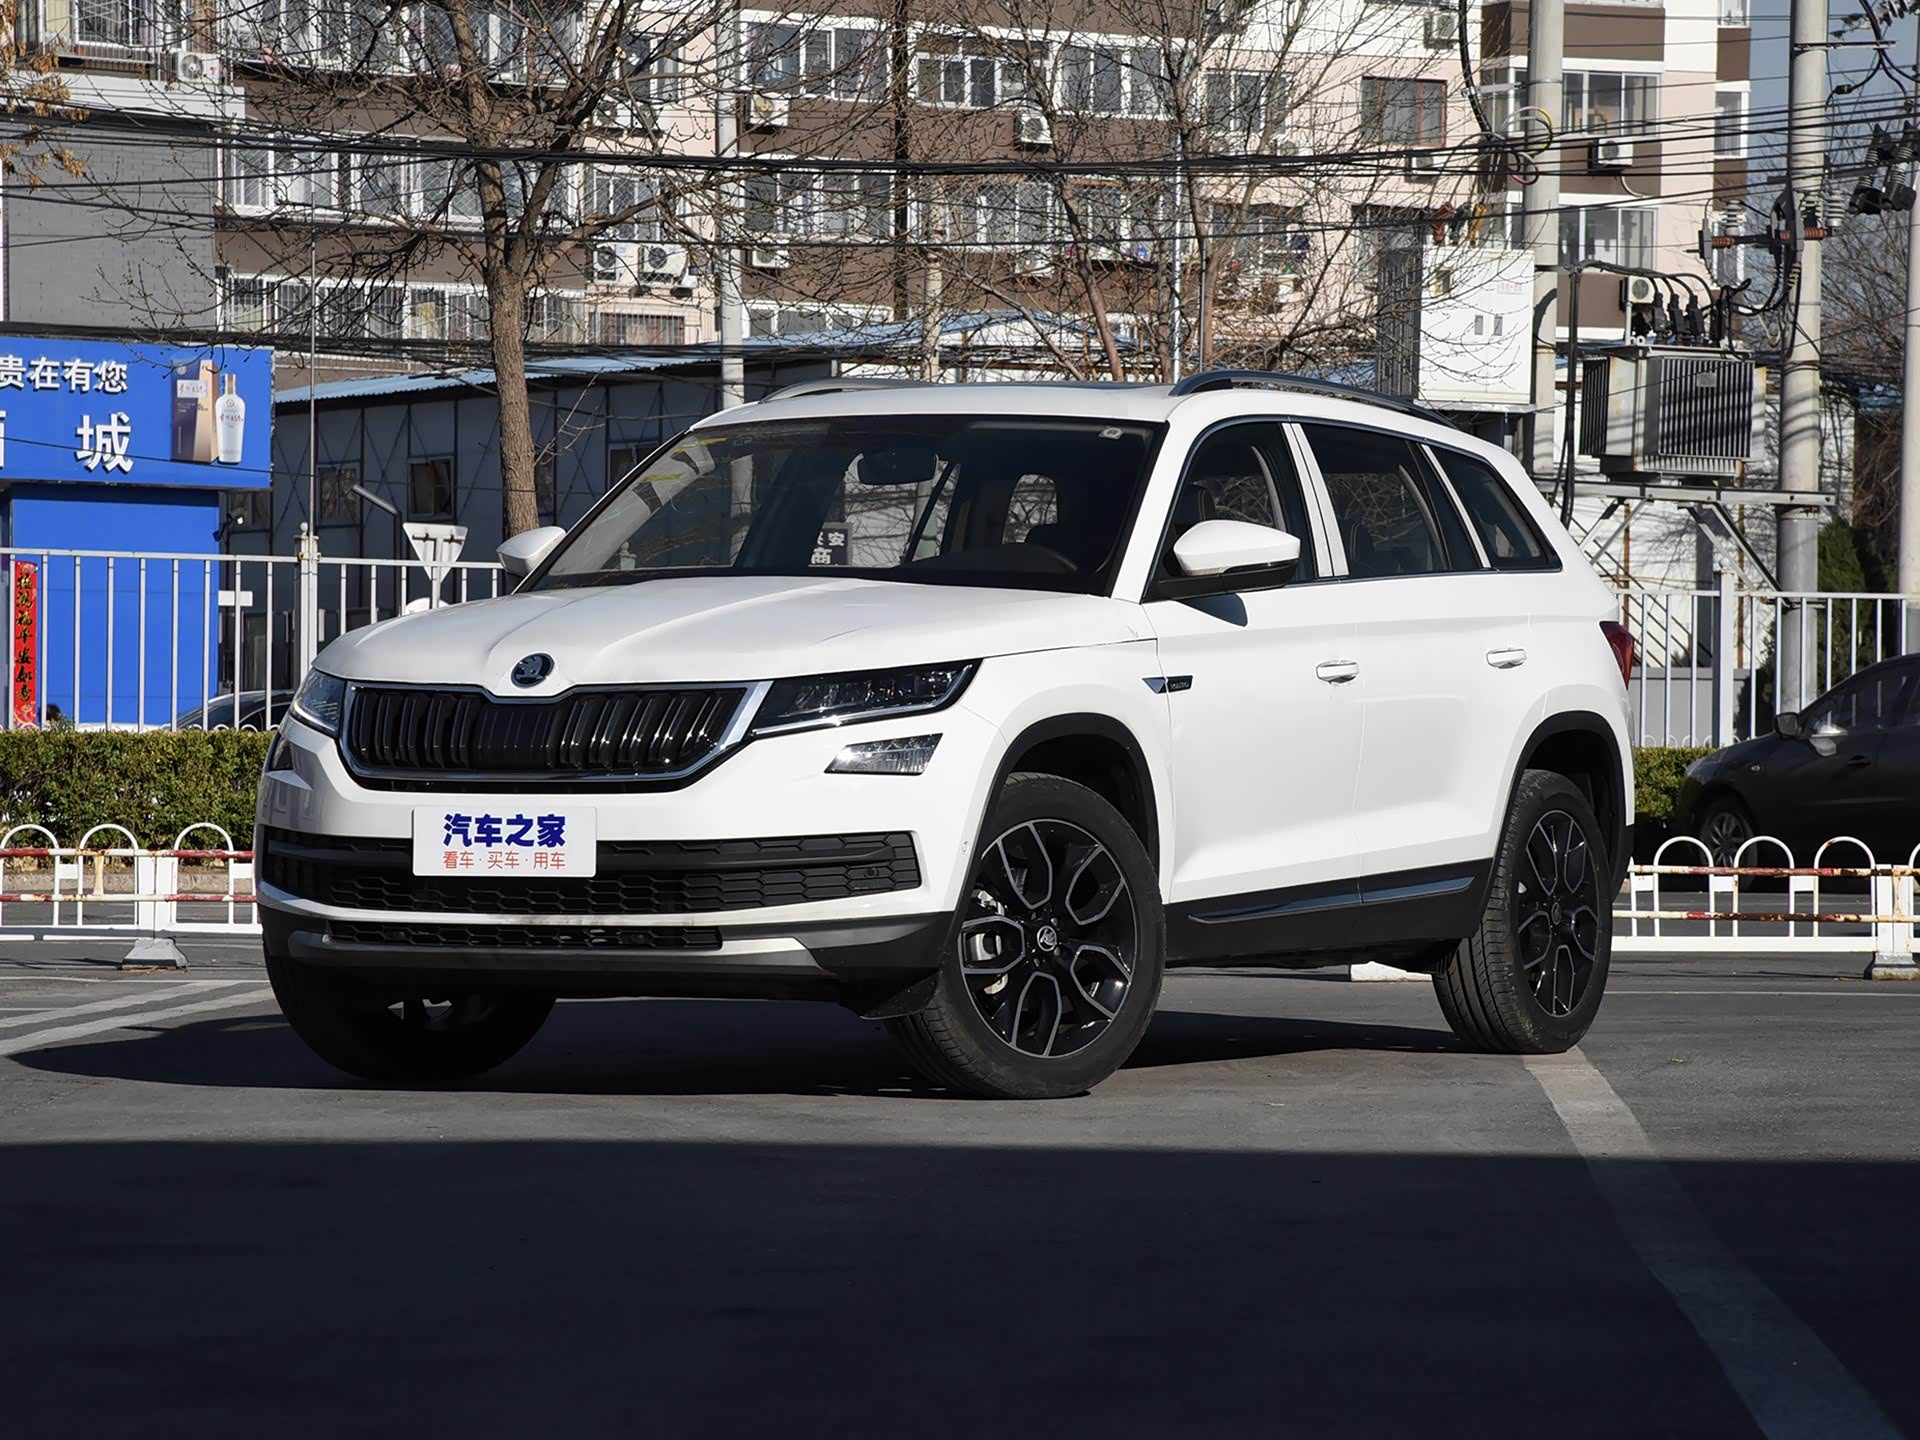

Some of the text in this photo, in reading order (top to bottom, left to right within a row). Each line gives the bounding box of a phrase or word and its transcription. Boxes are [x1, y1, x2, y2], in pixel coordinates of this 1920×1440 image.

[0, 354, 128, 393] 贵在有您
[443, 813, 566, 848] 汽车之家
